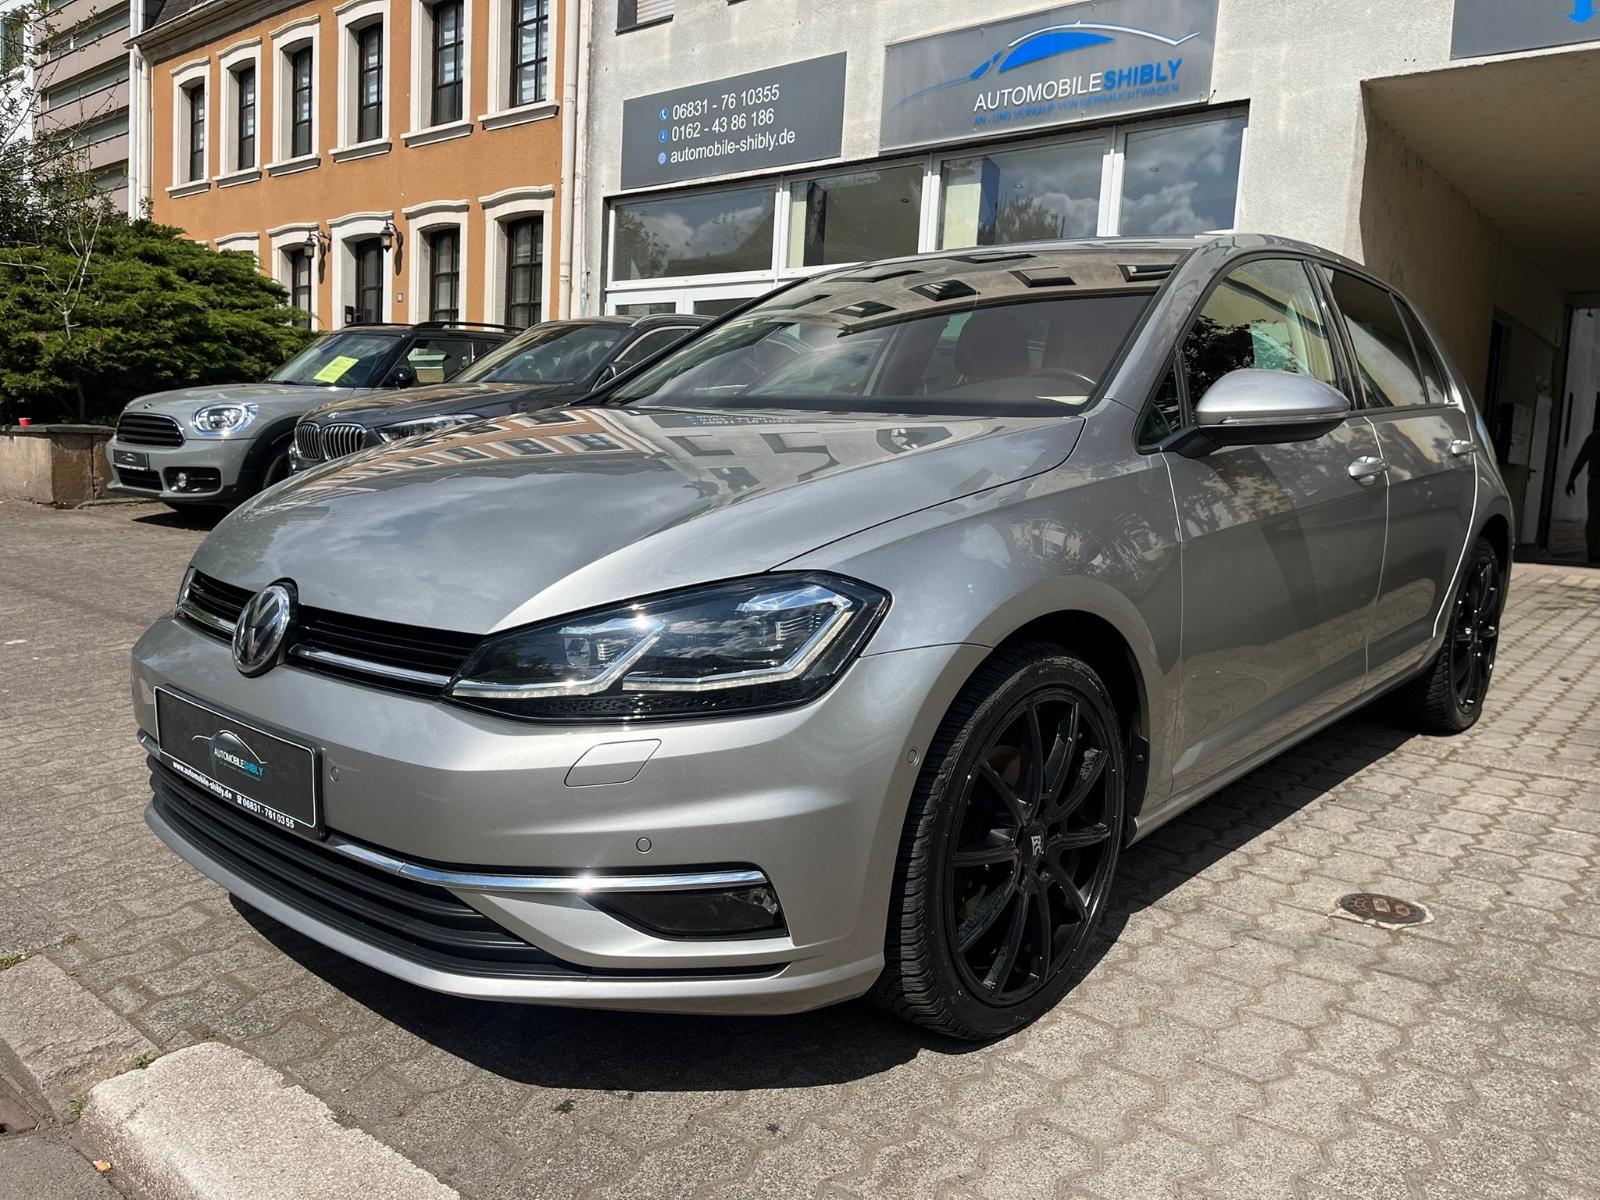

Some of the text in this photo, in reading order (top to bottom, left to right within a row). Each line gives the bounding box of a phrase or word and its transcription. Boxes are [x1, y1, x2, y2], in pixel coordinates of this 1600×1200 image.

[672, 98, 709, 121] 06831
[721, 92, 737, 111] 76
[740, 84, 780, 106] 10355
[671, 121, 701, 142] 0162
[712, 116, 728, 134] 43
[731, 112, 747, 131] 86
[751, 107, 774, 127] 186
[670, 128, 796, 164] automobile-shibly.de
